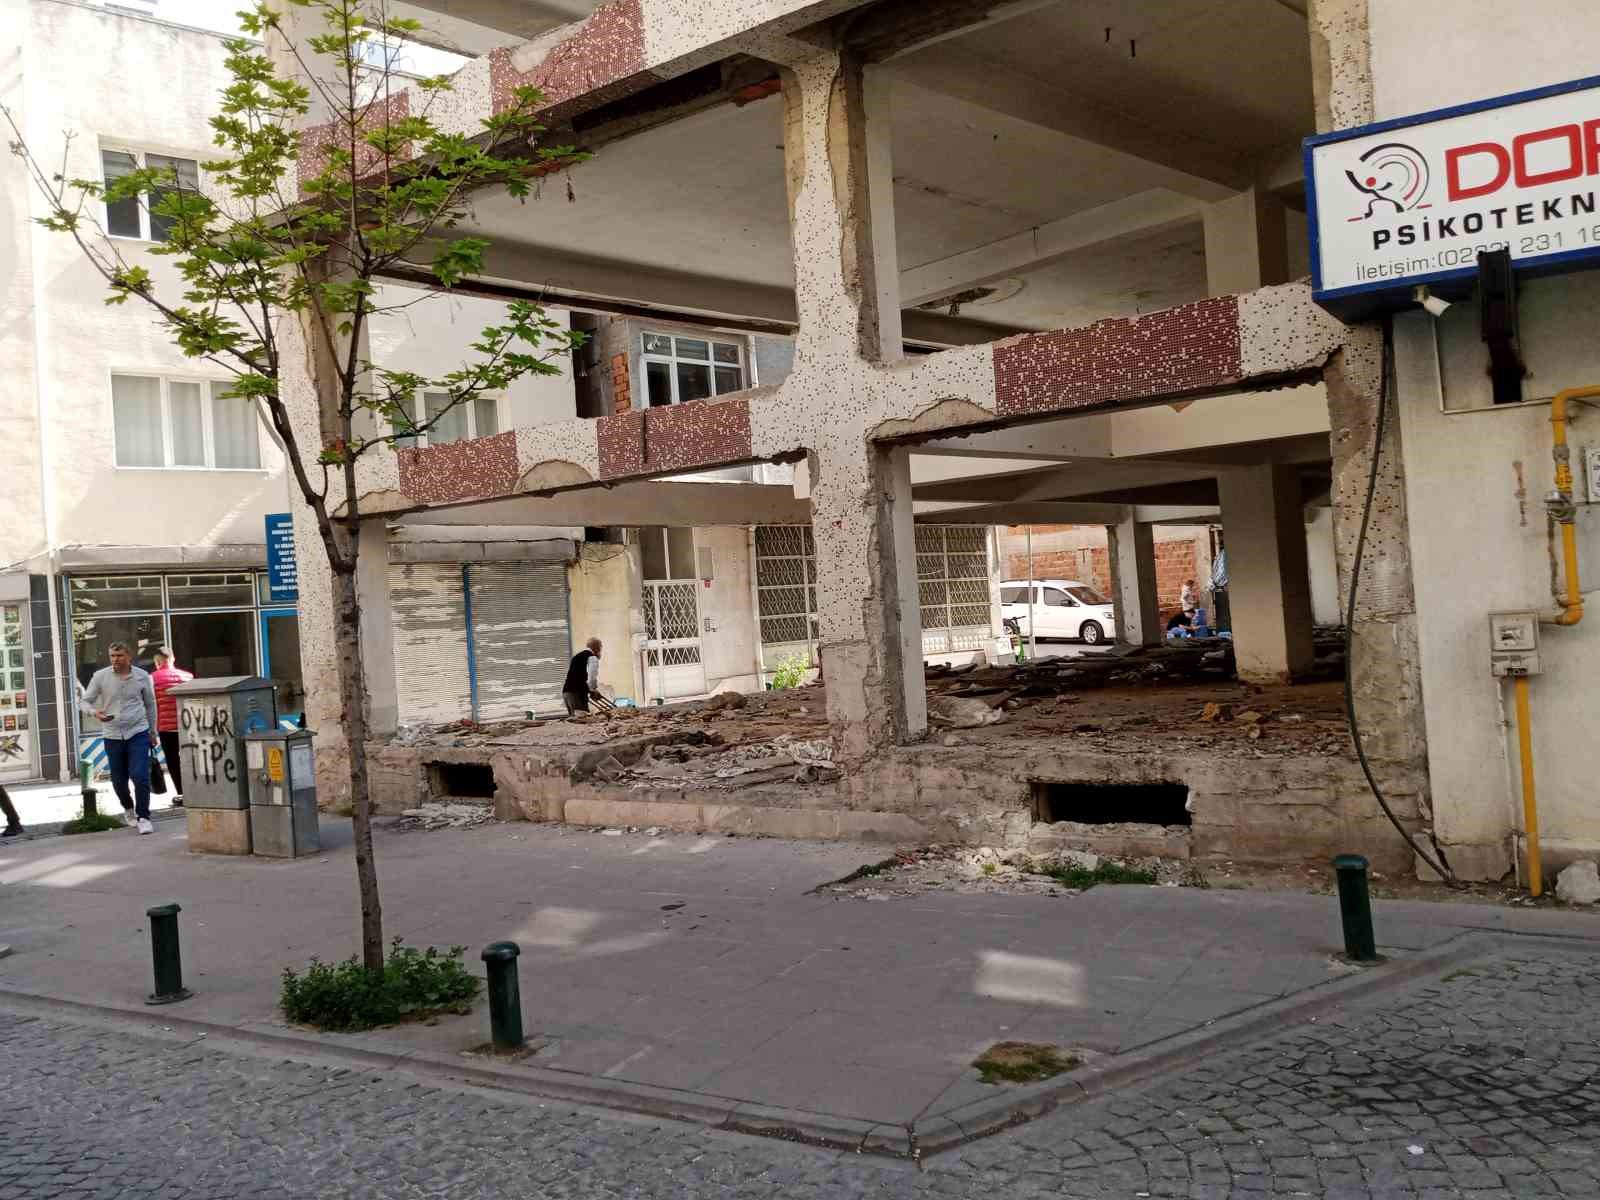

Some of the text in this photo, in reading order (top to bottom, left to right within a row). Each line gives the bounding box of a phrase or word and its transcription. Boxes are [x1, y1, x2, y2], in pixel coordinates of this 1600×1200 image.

[1445, 118, 1600, 201] DO
[1373, 192, 1595, 250] PSİKOTEKN
[1356, 241, 1510, 282] İletişim:(02
[1520, 232, 1563, 254] 231
[181, 706, 235, 738] OYLAR
